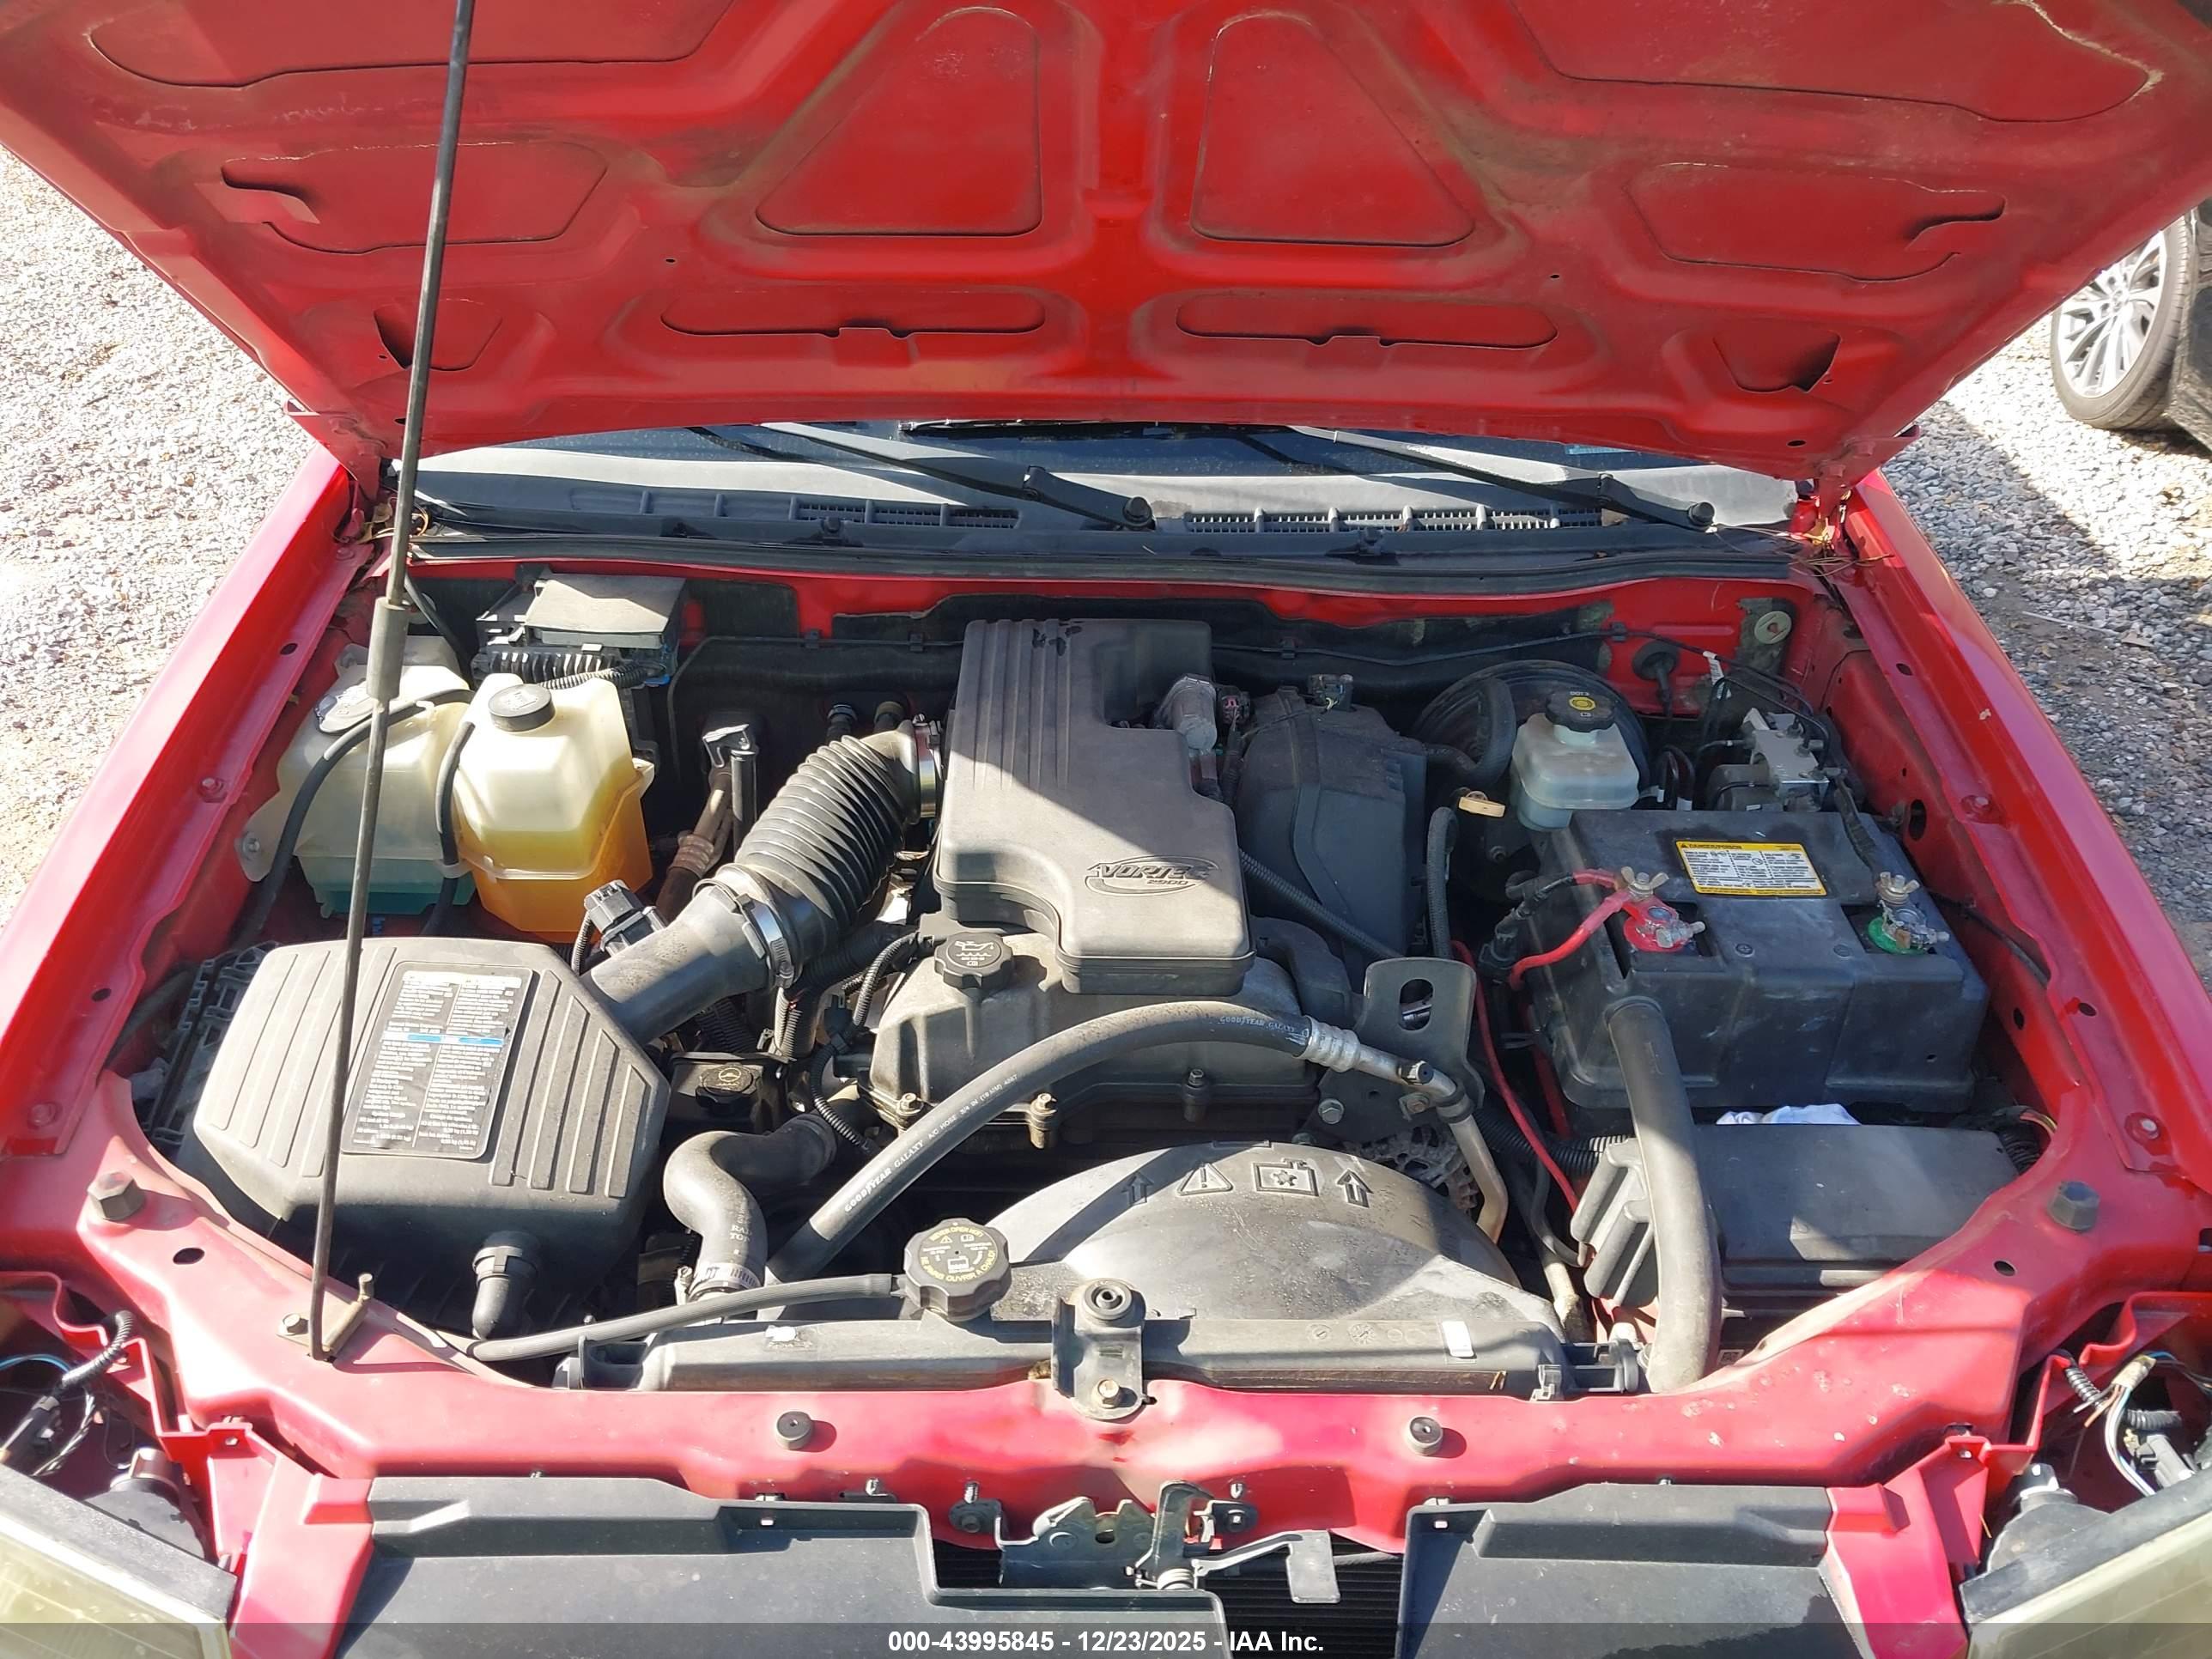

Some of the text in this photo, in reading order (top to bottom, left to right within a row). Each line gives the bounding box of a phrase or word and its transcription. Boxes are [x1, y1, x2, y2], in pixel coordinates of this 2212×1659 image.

[1097, 864, 1211, 880] VORTEC
[1219, 1015, 1296, 1033] GOODYEAR GALAXY
[844, 1168, 893, 1212] GOODYEAR
[894, 1139, 925, 1169] GALAXY
[928, 1127, 940, 1139] A/C
[940, 1115, 958, 1131] HOSE
[960, 1105, 970, 1115] 3/4
[945, 1272, 977, 1282] OUVRIR
